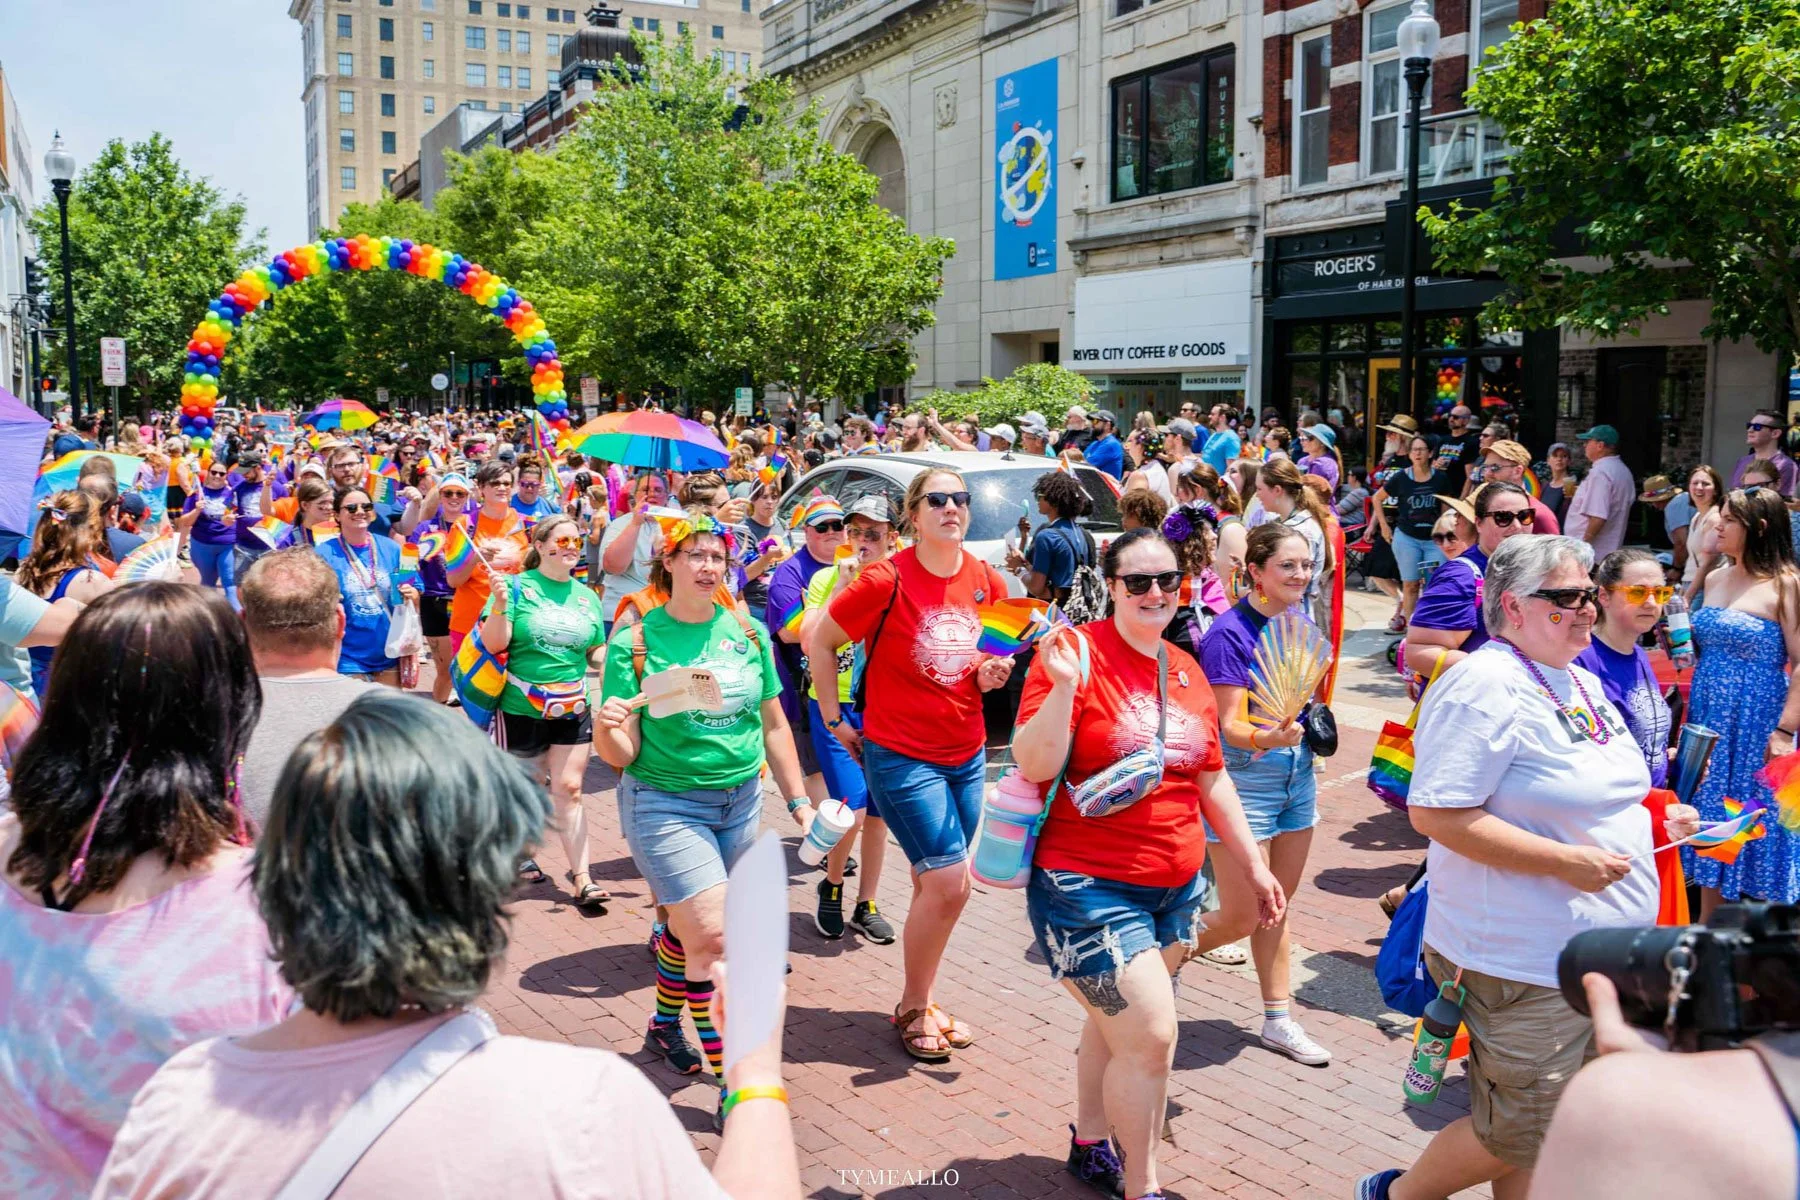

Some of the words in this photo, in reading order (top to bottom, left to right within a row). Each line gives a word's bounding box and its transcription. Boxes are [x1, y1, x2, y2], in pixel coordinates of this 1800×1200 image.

[1218, 76, 1228, 158] MUSEUM
[1126, 103, 1134, 164] TATTO
[1314, 254, 1376, 277] ROGER'S
[1358, 281, 1370, 291] OF
[1372, 279, 1393, 289] HAIR
[1395, 276, 1429, 288] DEGN
[1073, 348, 1100, 361] RIVER
[1102, 347, 1124, 361] CITY
[1127, 345, 1166, 360] COFFEE
[1168, 345, 1178, 358] &
[1181, 342, 1226, 357] GOODS
[1220, 376, 1242, 384] GOODS
[934, 673, 964, 684] PRIDE
[703, 715, 737, 727] PRIDE
